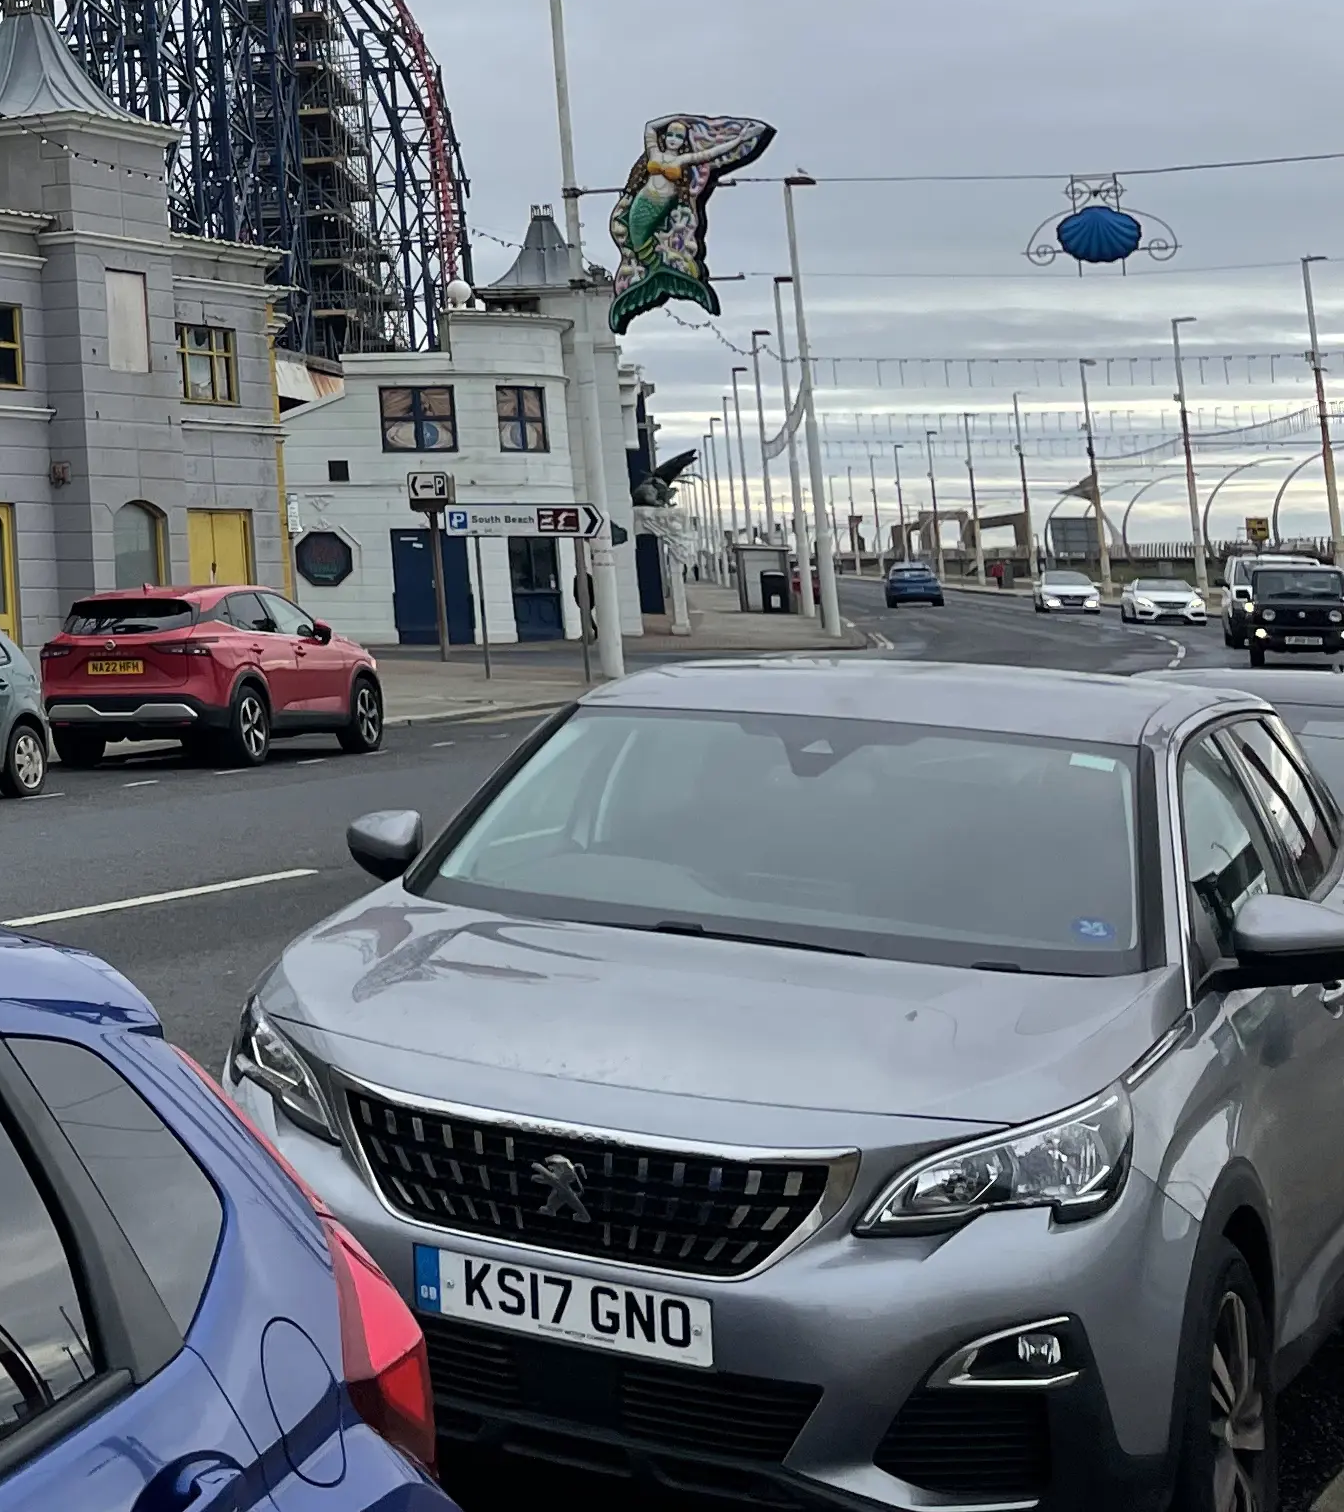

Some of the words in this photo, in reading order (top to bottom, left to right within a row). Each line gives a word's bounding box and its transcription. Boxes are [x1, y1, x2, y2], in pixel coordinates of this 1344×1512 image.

[472, 515, 501, 525] South
[505, 515, 535, 525] Beach
[92, 662, 117, 673] NA22
[464, 1259, 573, 1325] KS17
[589, 1285, 692, 1349] GNO
